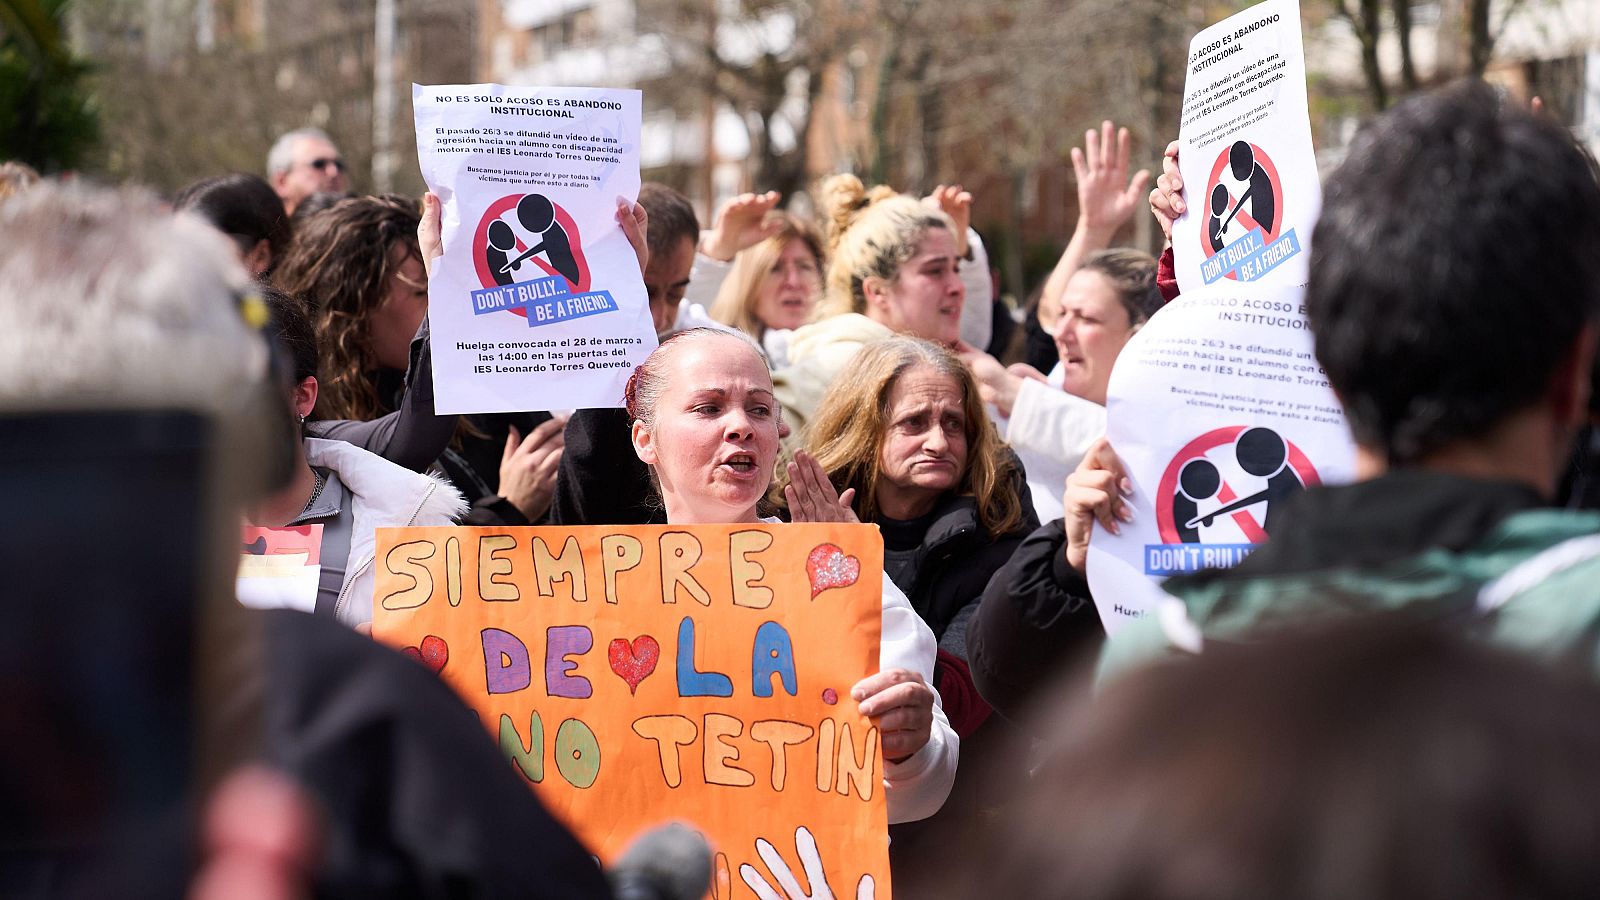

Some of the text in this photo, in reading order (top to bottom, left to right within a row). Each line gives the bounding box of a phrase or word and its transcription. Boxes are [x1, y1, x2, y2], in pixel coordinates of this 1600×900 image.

[1198, 40, 1221, 58] ACOSO
[1222, 35, 1232, 45] ES
[1234, 14, 1280, 40] ABANDONO
[1192, 43, 1244, 75] INSTITUCIONAL
[456, 95, 470, 103] ES
[473, 95, 503, 103] SOLO
[507, 97, 543, 106] ACOSO
[564, 99, 622, 111] ABANDONO
[490, 106, 575, 118] INSTITUCIONAL
[436, 127, 445, 135] El
[447, 127, 480, 136] pasado
[516, 130, 551, 139] difundió
[436, 136, 477, 145] agresión
[479, 137, 504, 145] hacia
[519, 139, 550, 148] alumno
[570, 143, 623, 154] discapacidad
[497, 147, 511, 155] IES
[513, 149, 553, 158] Leonardo
[555, 152, 582, 160] Torres
[584, 154, 621, 163] Quevedo.
[467, 166, 502, 174] Buscamos
[503, 168, 529, 176] justicia
[1203, 235, 1263, 282] DON'T BULLY...
[1241, 237, 1295, 282] BE A FRIEND.
[476, 279, 567, 310] DON'T BULLY...
[535, 294, 612, 322] BE A FRIEND.
[1243, 299, 1292, 313] ACOSO
[456, 341, 495, 351] Huelga
[498, 339, 557, 350] convocada
[560, 338, 570, 347] el
[573, 337, 587, 347] 28
[590, 337, 602, 345] de
[605, 337, 634, 345] marzo
[479, 353, 495, 362] las
[498, 352, 528, 361] 14:00
[548, 351, 564, 360] las
[567, 349, 608, 360] puertas
[611, 348, 626, 357] del
[474, 360, 631, 374] IES Leonardo Torres Quevedo
[1150, 546, 1200, 571] DON'T
[382, 529, 774, 610] SIEMPRE
[481, 616, 798, 699] DE LA
[469, 709, 601, 790] NO
